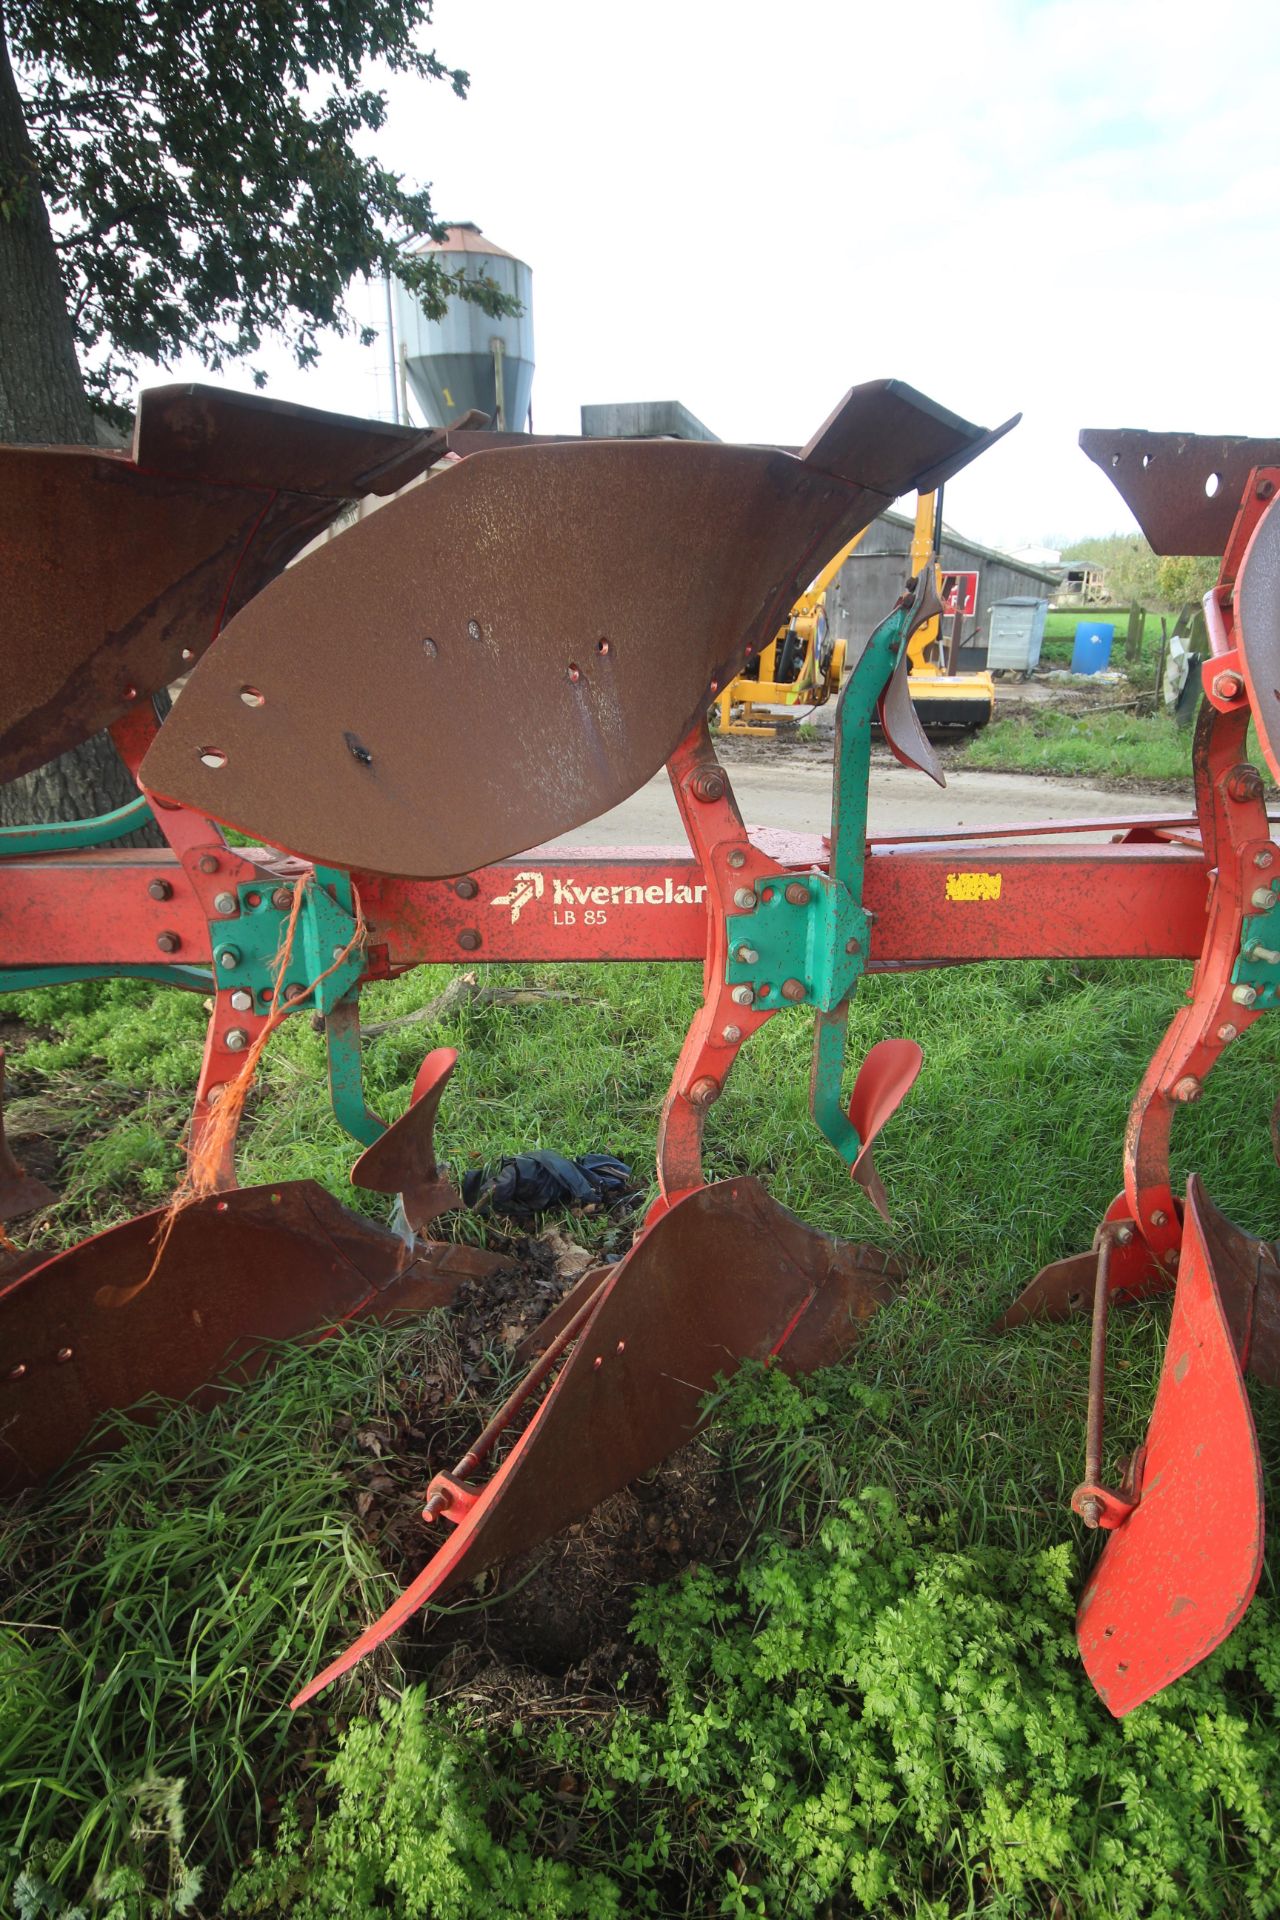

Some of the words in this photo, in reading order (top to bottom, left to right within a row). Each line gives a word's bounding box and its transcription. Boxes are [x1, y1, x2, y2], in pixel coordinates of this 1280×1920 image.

[442, 388, 455, 407] 1
[552, 878, 708, 905] Kvernelan
[553, 910, 576, 925] LB
[583, 910, 607, 925] 85
